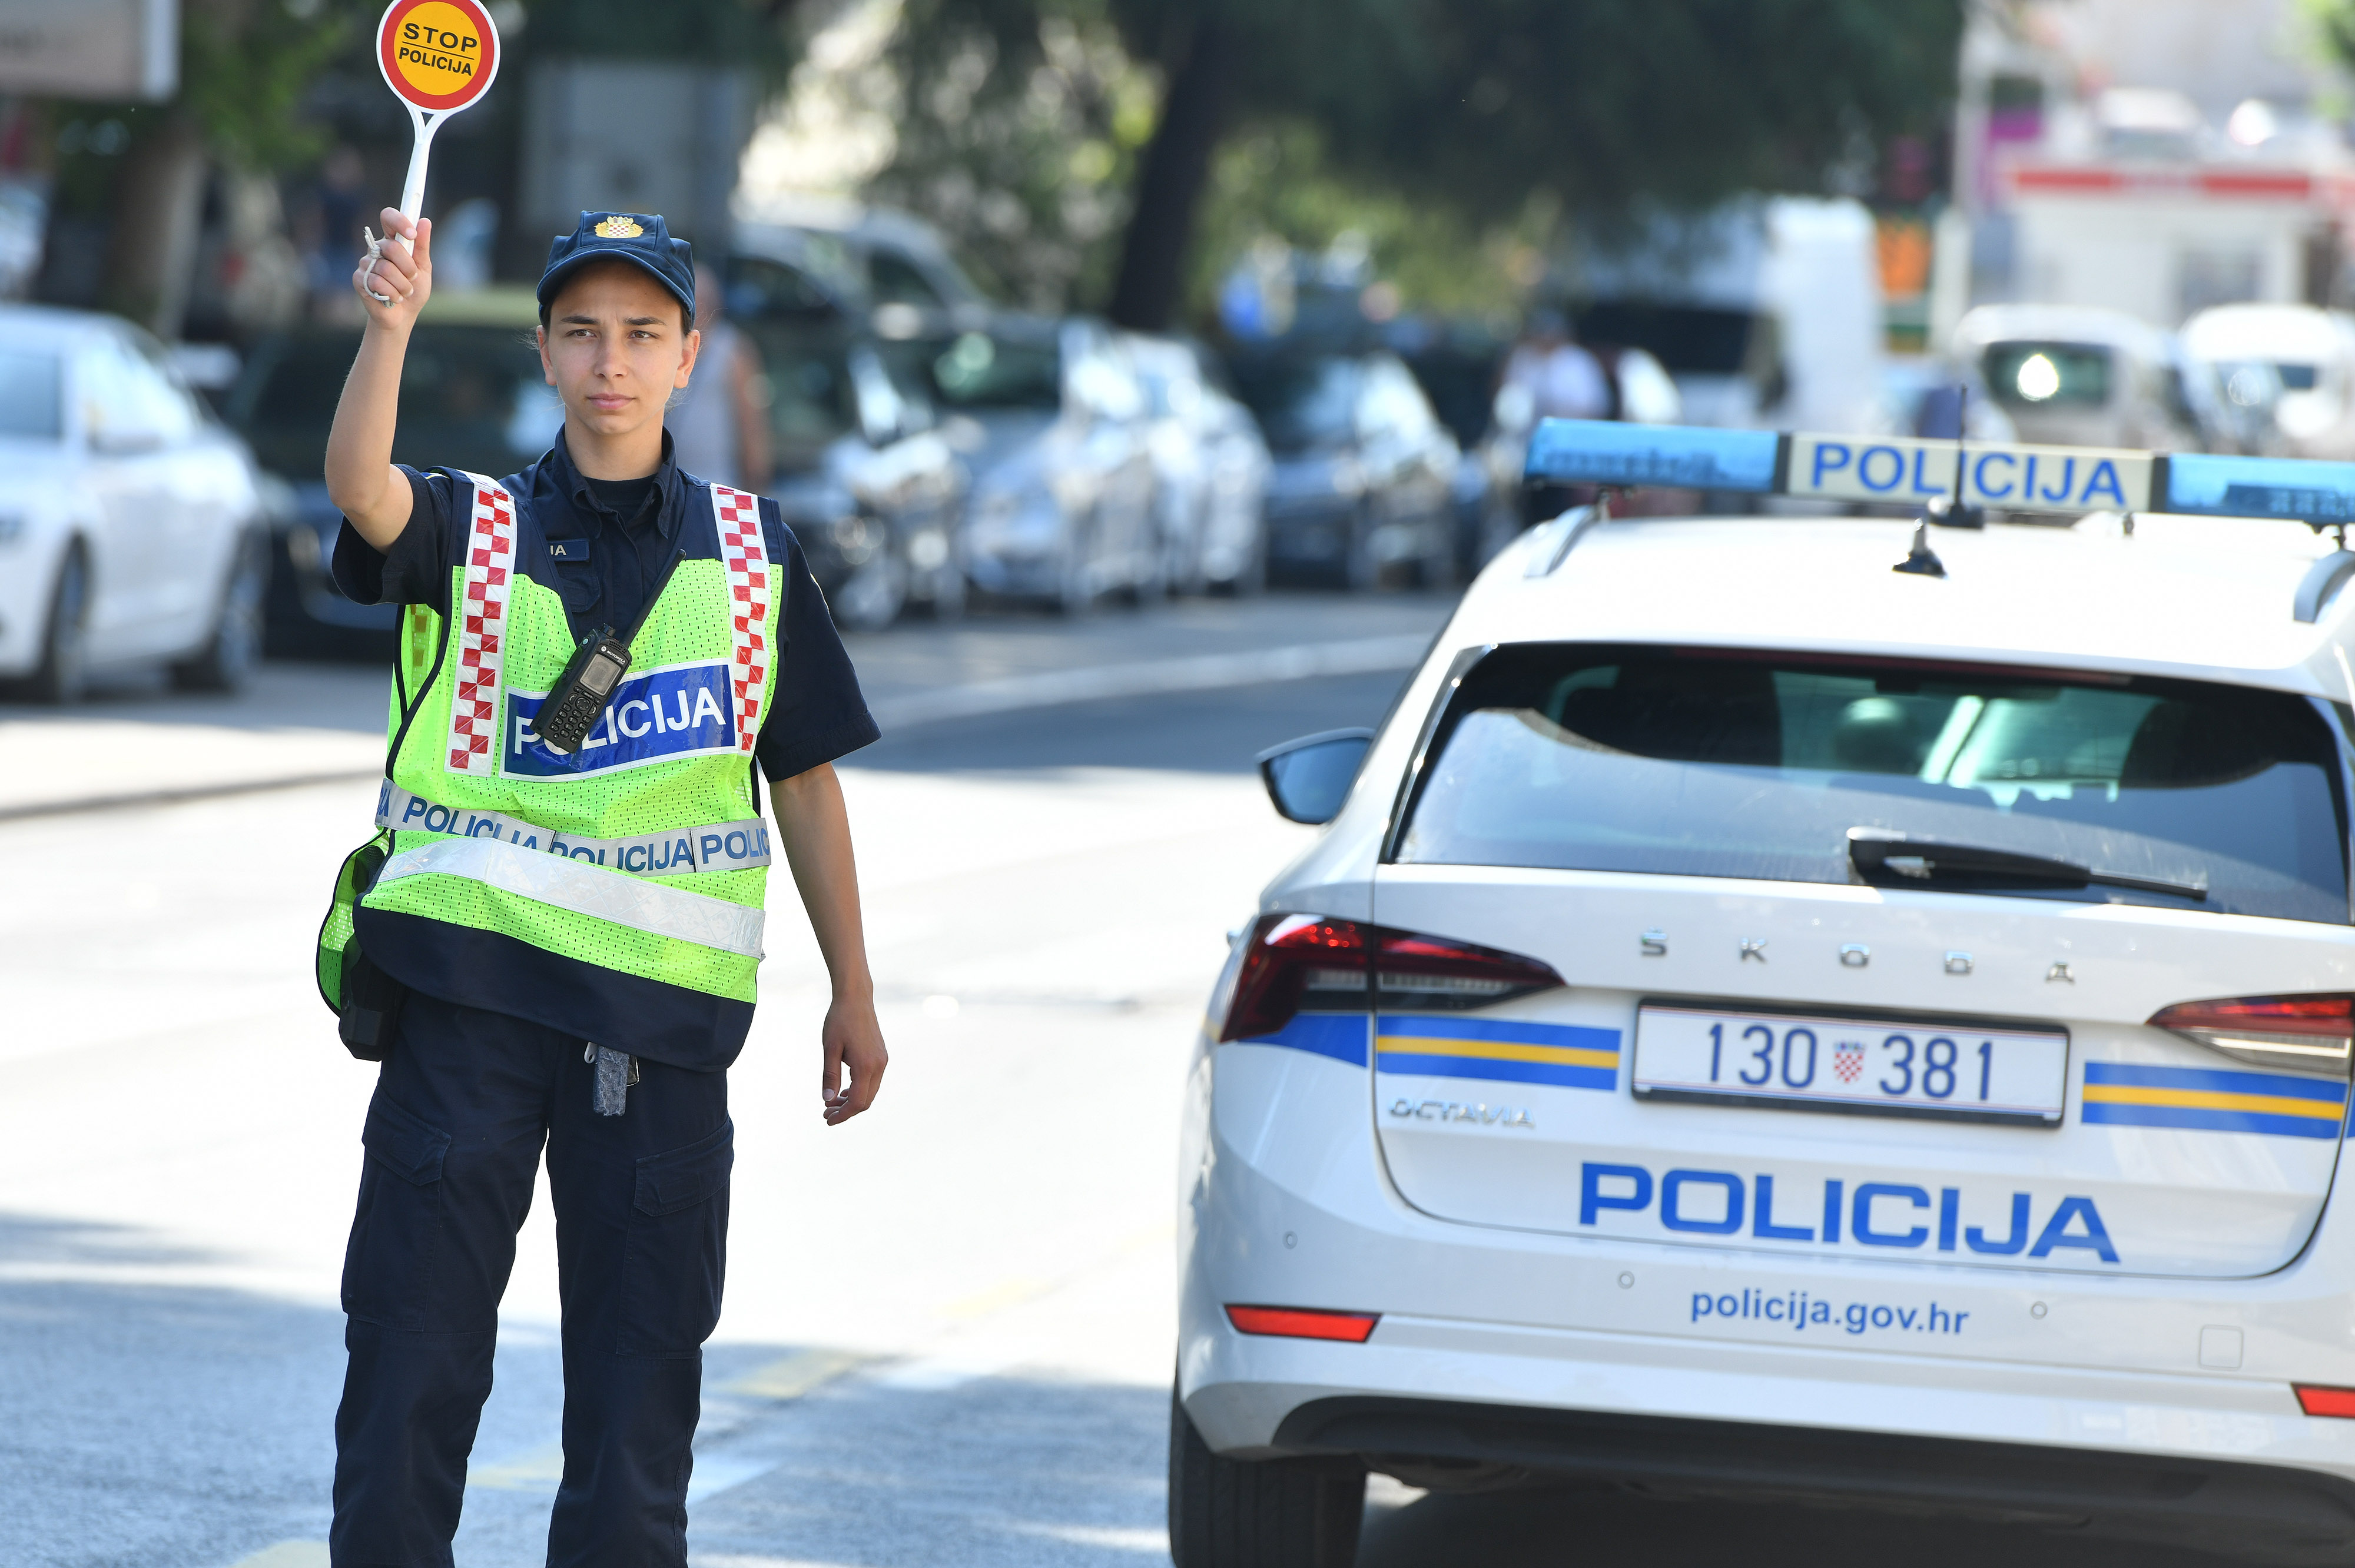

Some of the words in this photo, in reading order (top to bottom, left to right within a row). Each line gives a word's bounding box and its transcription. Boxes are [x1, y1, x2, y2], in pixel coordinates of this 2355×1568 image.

[403, 22, 477, 52] STOP
[399, 46, 472, 77] POLICIJA
[1812, 443, 2125, 507] POLICIJA
[606, 650, 626, 663] MOTOROLA
[515, 687, 727, 755] PLICIJA
[1709, 1023, 1817, 1089] 130
[1880, 1034, 1992, 1101] 381
[1389, 1098, 1535, 1129] OCTAVIA
[1579, 1161, 2121, 1264] POLICIJA
[1691, 1288, 1969, 1334] policija.gov.hr
